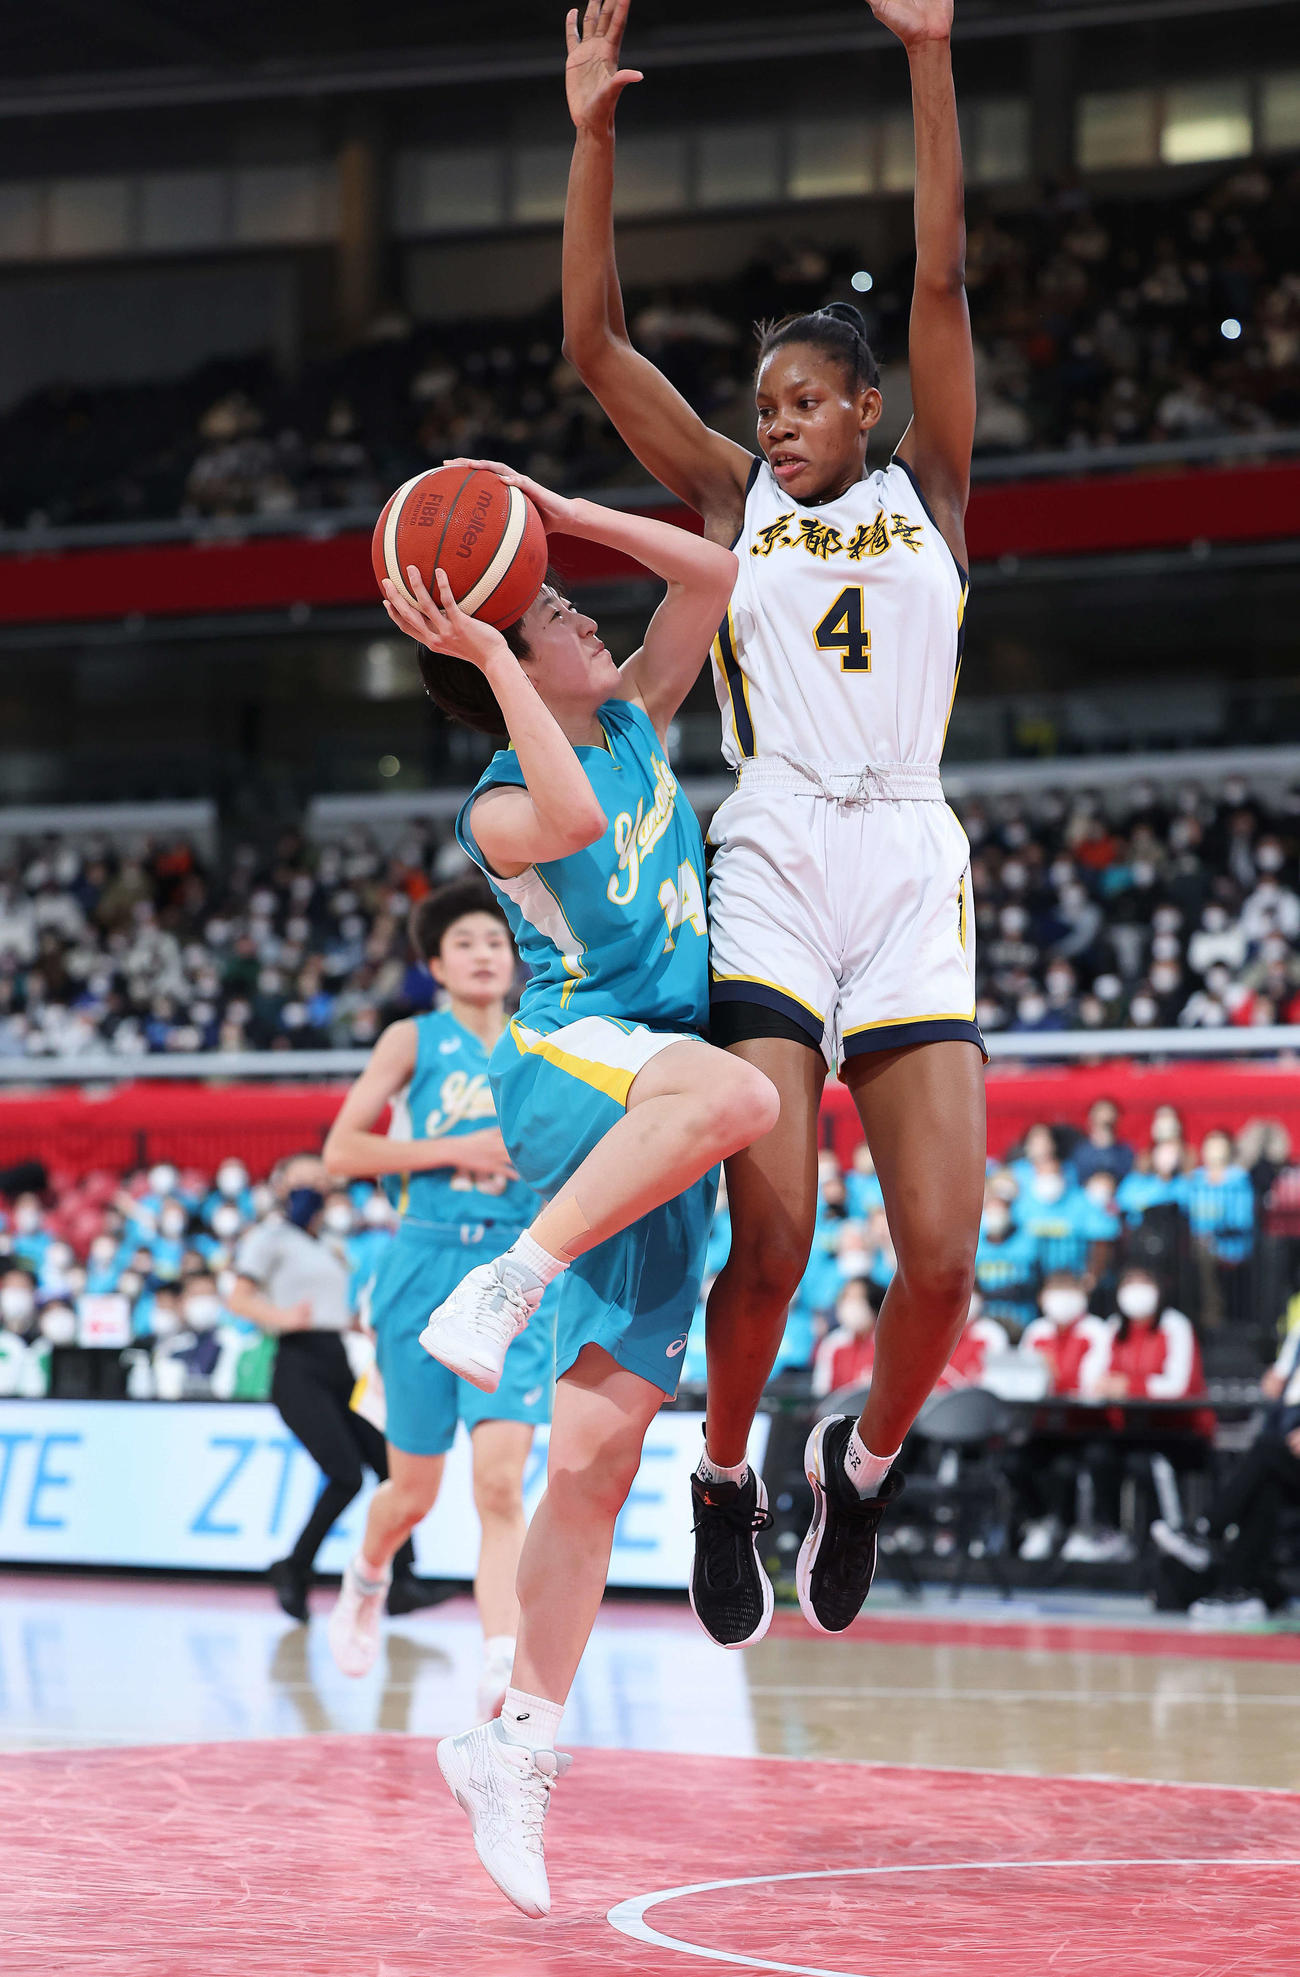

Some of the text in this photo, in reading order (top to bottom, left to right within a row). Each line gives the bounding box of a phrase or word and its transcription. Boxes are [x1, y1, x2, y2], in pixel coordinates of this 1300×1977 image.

[417, 493, 444, 527] FIBA
[456, 490, 493, 559] molten
[812, 584, 872, 673] 4
[188, 1434, 351, 1538] ZT
